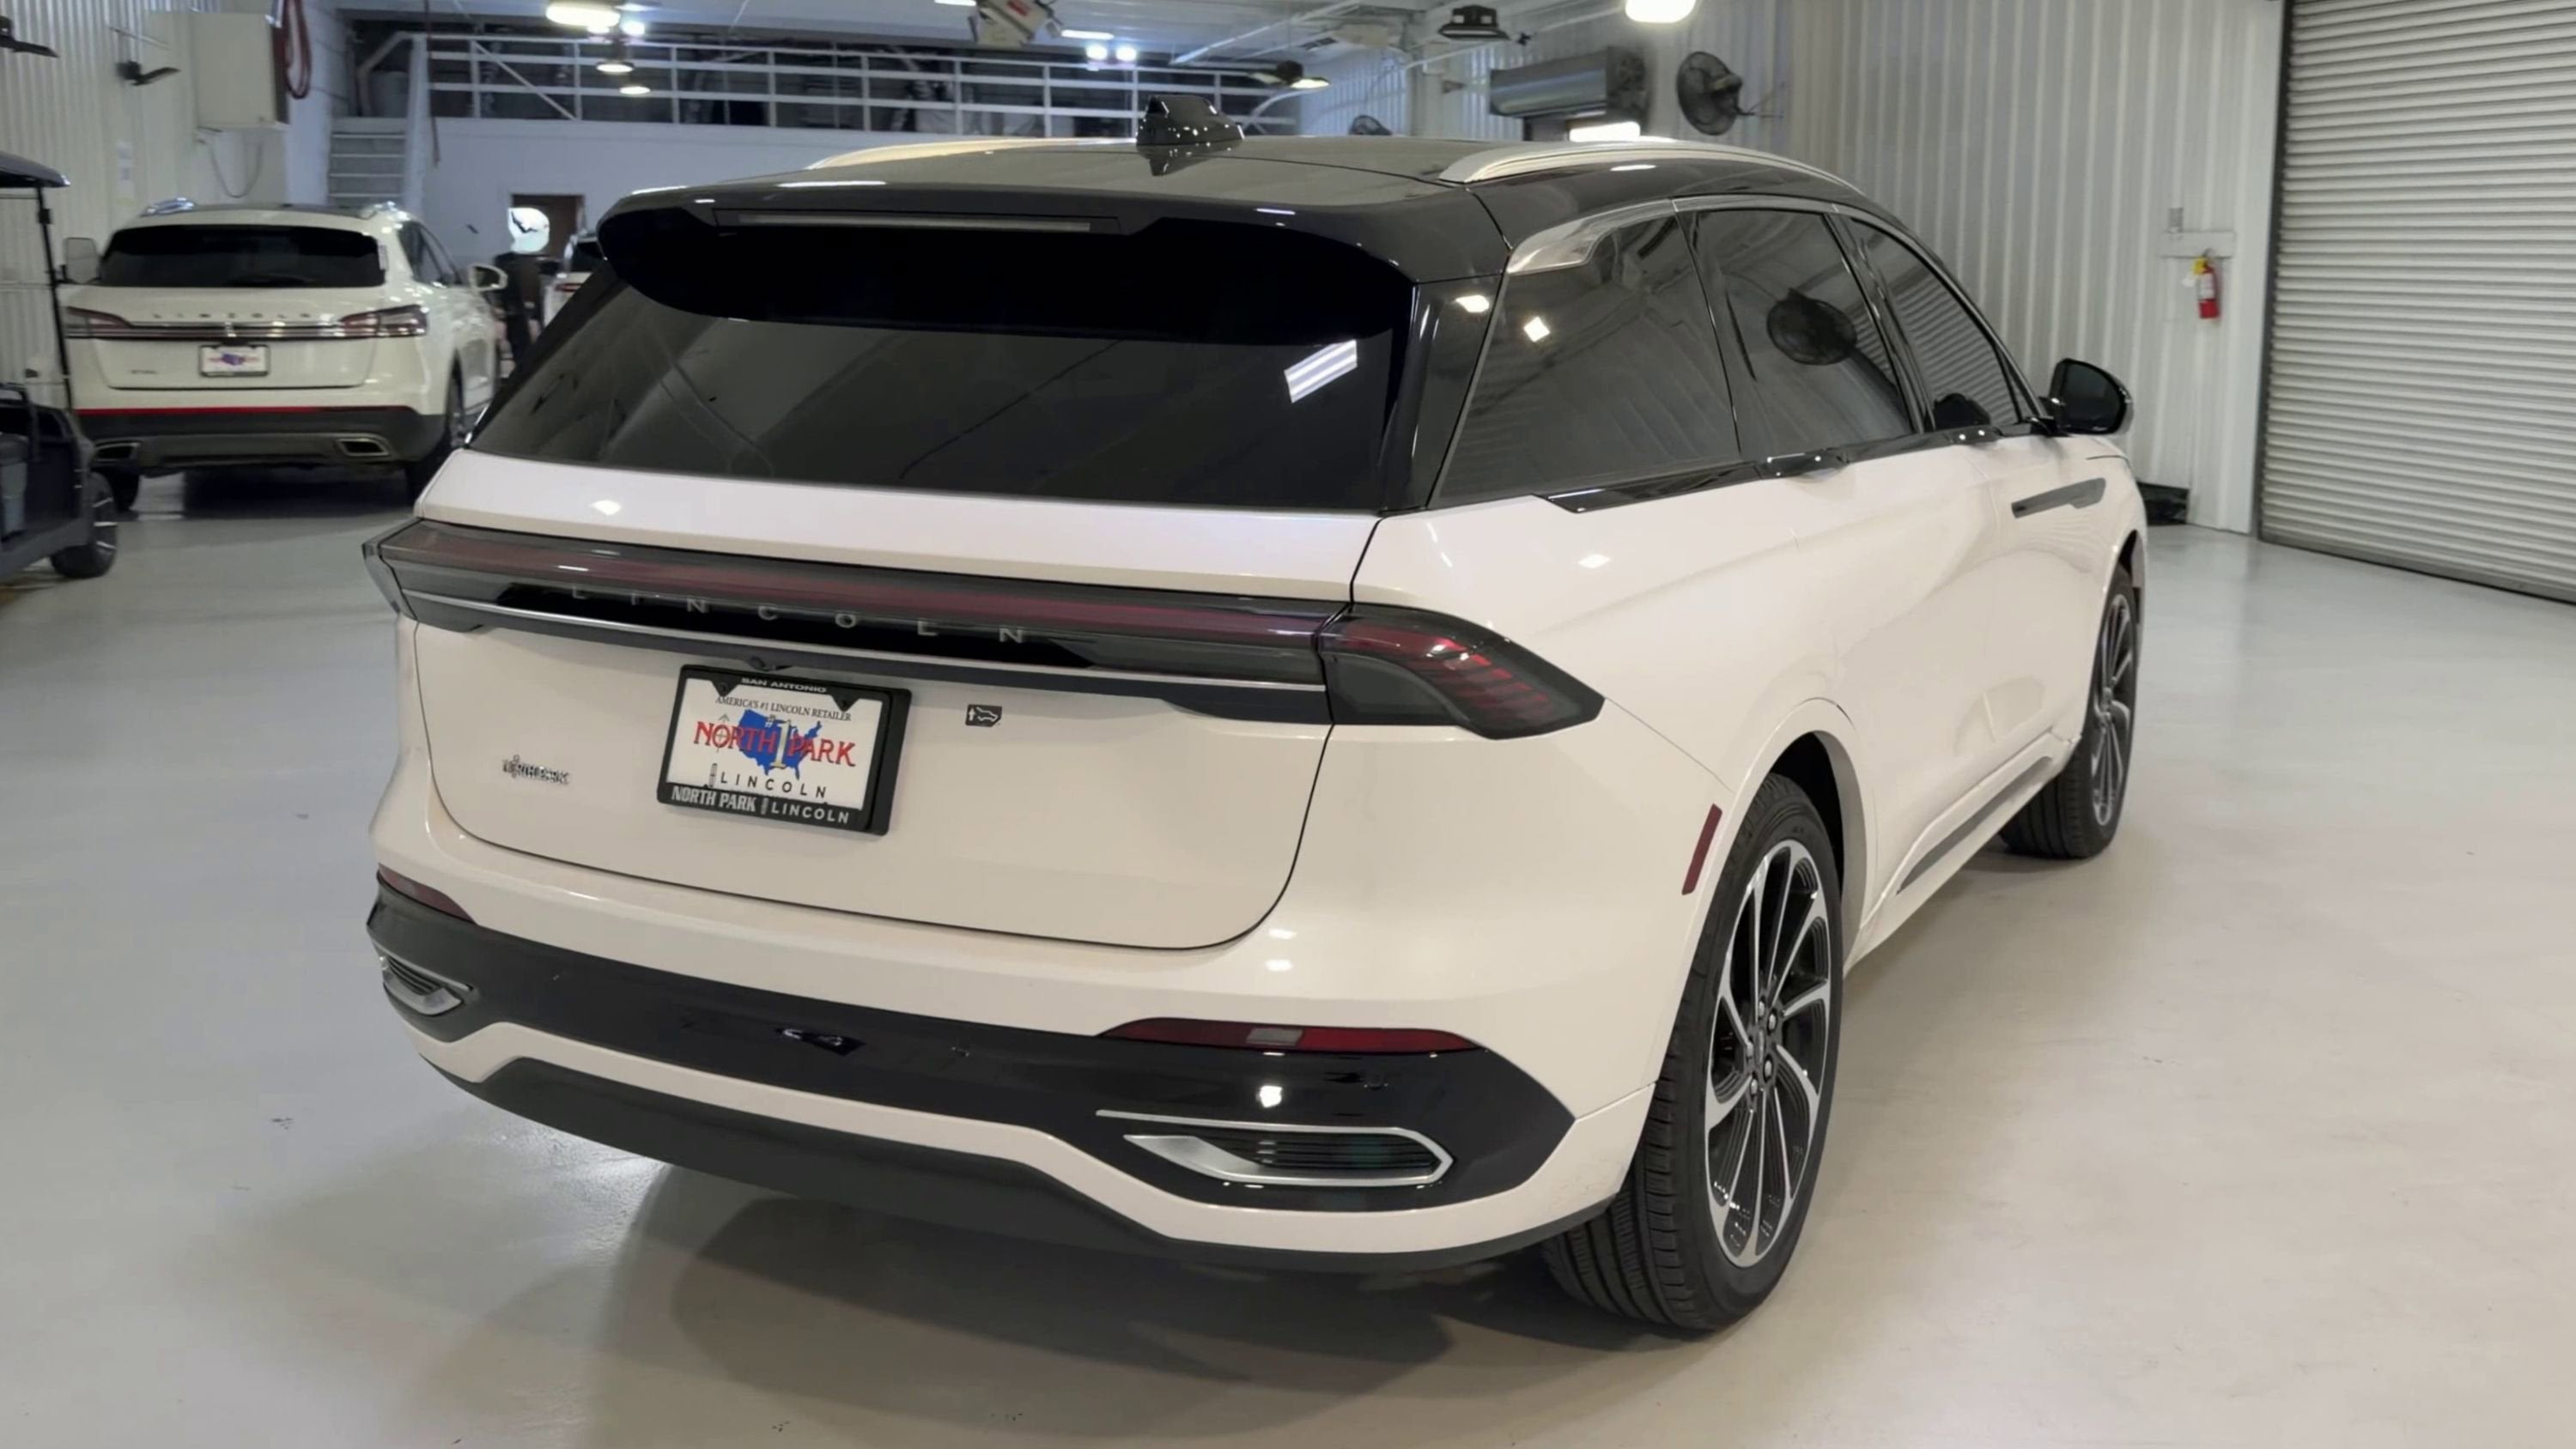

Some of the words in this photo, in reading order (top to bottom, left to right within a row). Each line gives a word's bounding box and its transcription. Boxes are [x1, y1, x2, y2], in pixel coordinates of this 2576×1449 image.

[572, 585, 1024, 644] LINCOLN
[741, 677, 767, 687] SAN
[770, 681, 827, 694] ANTONIO
[715, 696, 758, 709] AMERICA'S
[770, 702, 810, 717] LINCOLN
[811, 707, 852, 722] RETAILER
[694, 721, 777, 754] NORTH
[787, 732, 856, 767] PARK
[720, 771, 826, 799] LINCOLN
[671, 785, 716, 805] NORTH
[719, 791, 756, 812] PARK
[771, 802, 849, 825] LINCOLN
